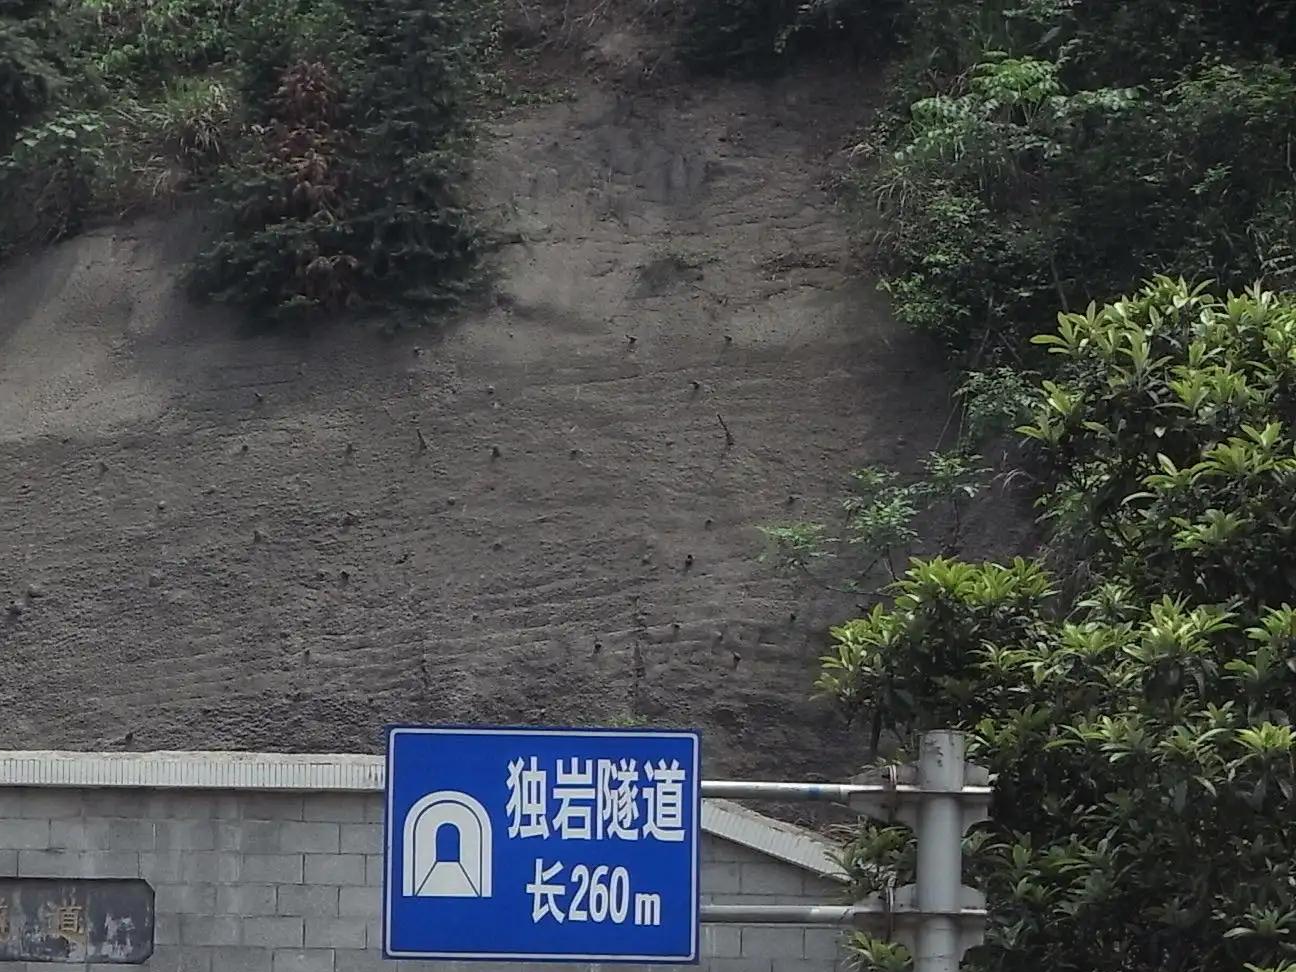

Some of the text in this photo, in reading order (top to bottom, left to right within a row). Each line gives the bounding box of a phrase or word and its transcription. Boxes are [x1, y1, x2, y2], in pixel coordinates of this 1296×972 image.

[506, 756, 686, 841] 独岩隧道
[526, 858, 661, 926] 长260m
